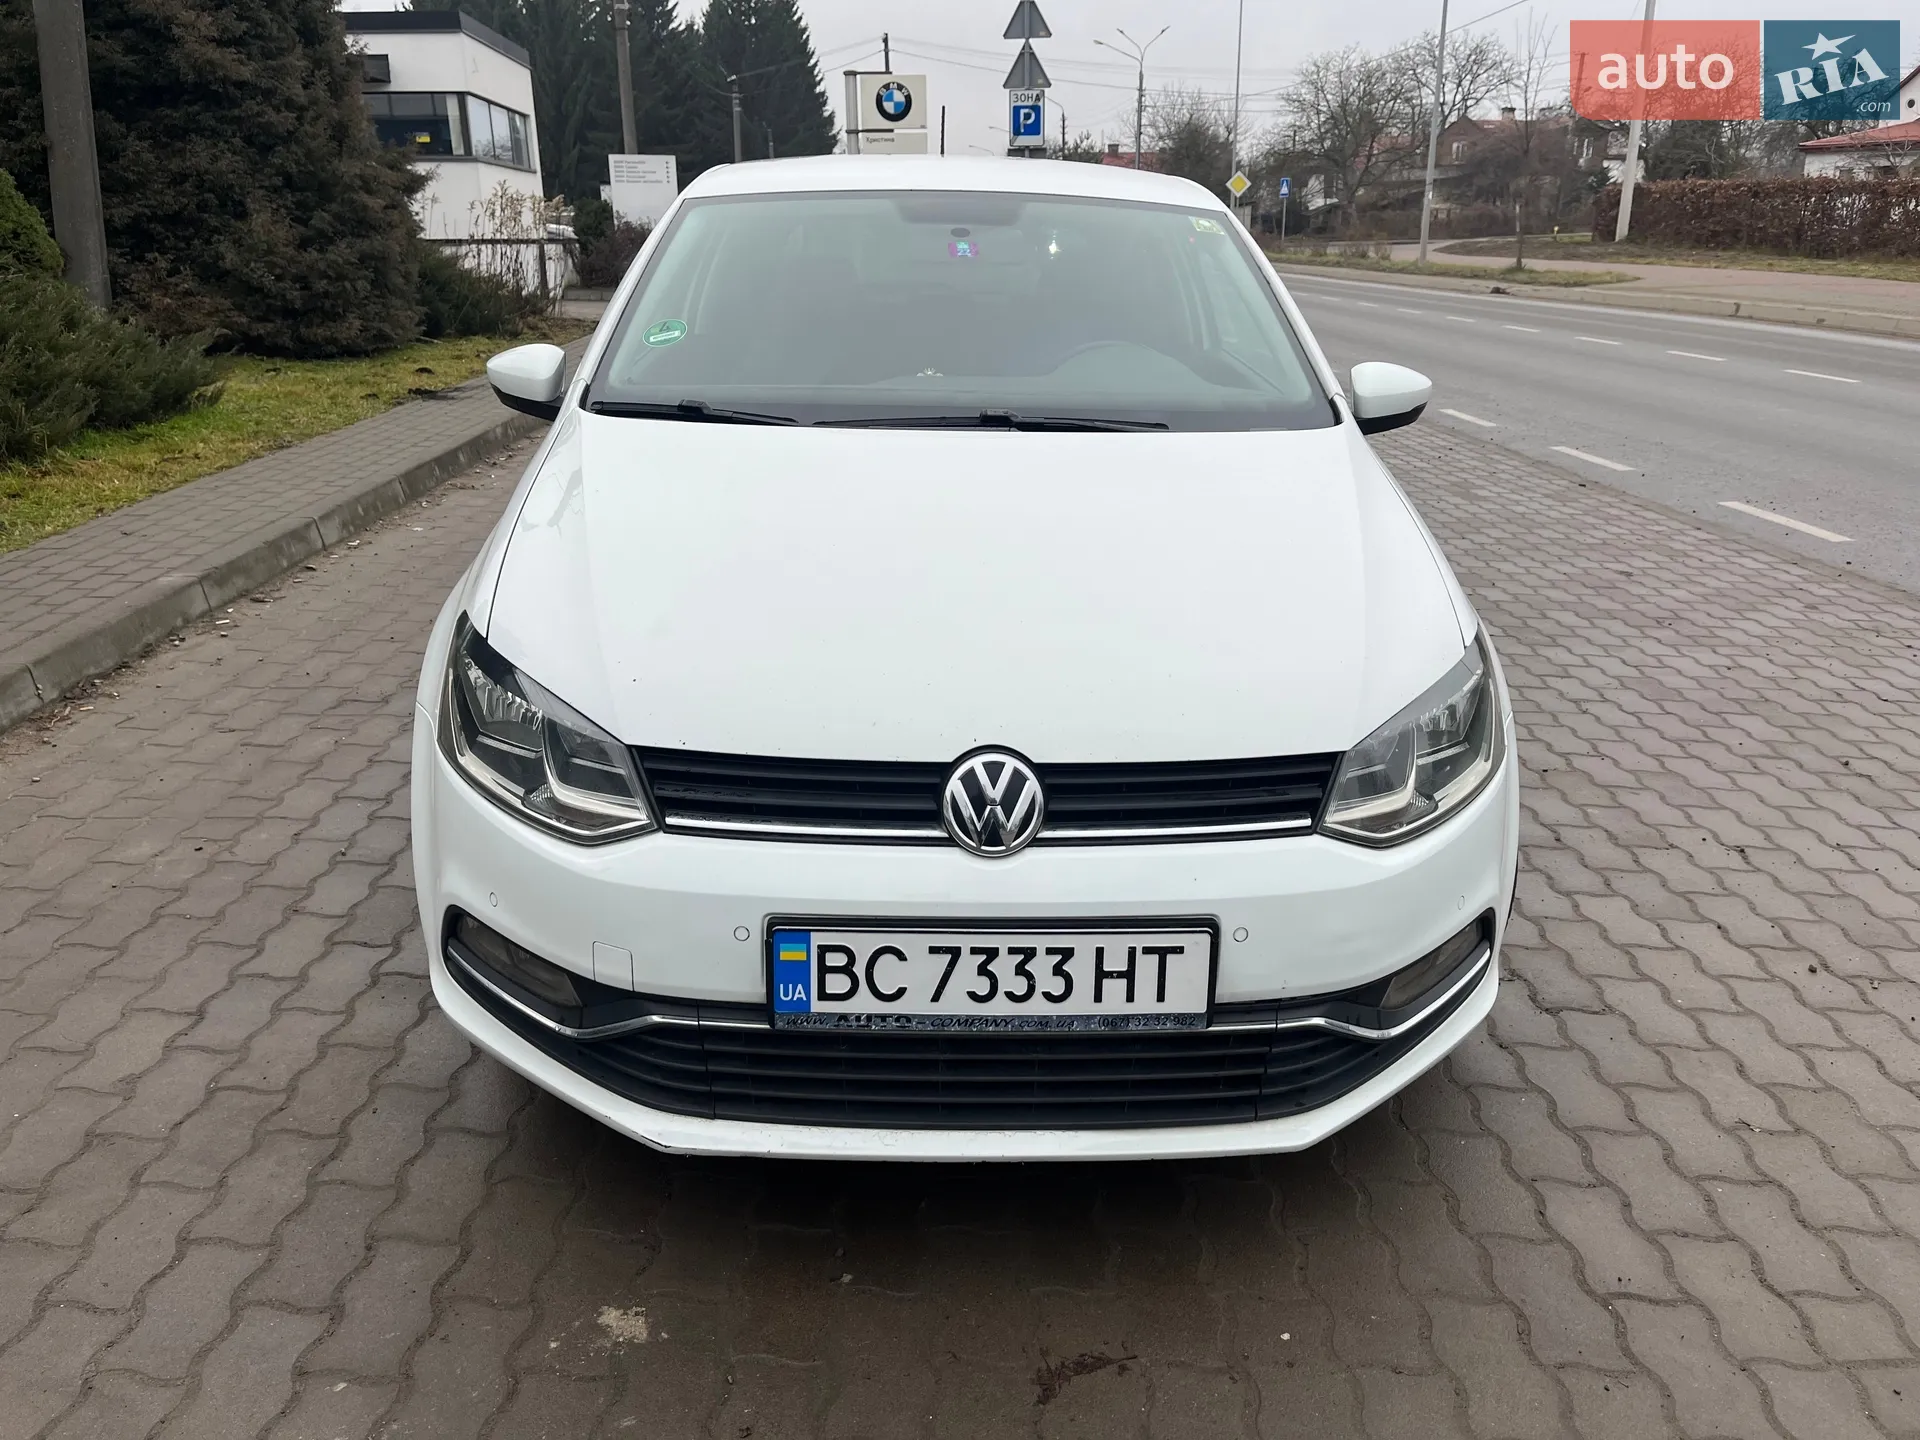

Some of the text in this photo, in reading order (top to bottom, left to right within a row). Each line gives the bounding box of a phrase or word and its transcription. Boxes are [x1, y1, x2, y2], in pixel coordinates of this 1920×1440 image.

[879, 82, 909, 96] BMW
[1012, 93, 1041, 103] ЗОНА
[1020, 108, 1036, 133] P
[816, 944, 1185, 1004] BC 7333 HT
[779, 983, 807, 1001] UA
[1133, 1016, 1150, 1027] 32
[1153, 1016, 1169, 1027] 32
[1172, 1016, 1196, 1027] 982
